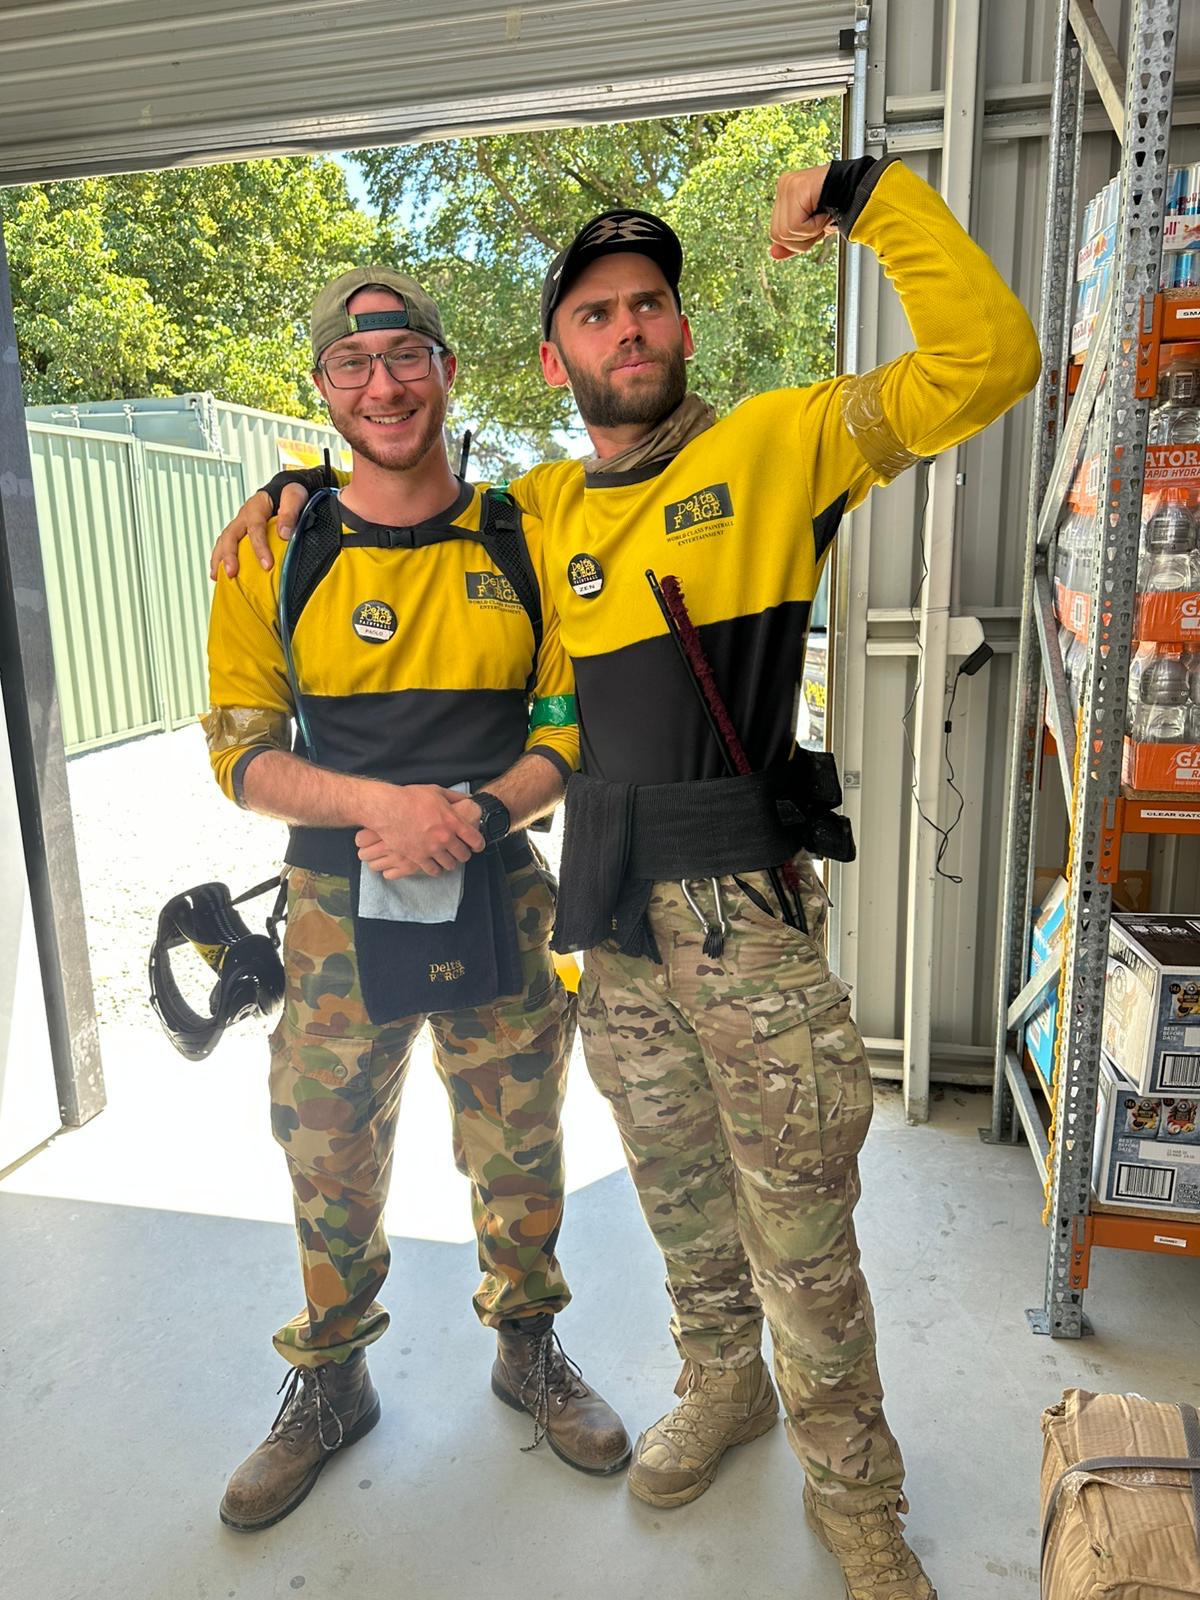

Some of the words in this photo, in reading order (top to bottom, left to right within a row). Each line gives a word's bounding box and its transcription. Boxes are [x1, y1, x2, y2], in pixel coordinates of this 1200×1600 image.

[1163, 222, 1177, 235] ull
[1145, 450, 1200, 467] ATOR
[677, 490, 716, 515] Delta
[674, 502, 722, 529] FRCE
[477, 585, 520, 602] FRCE
[429, 960, 463, 973] Delta
[429, 967, 465, 982] FRCE
